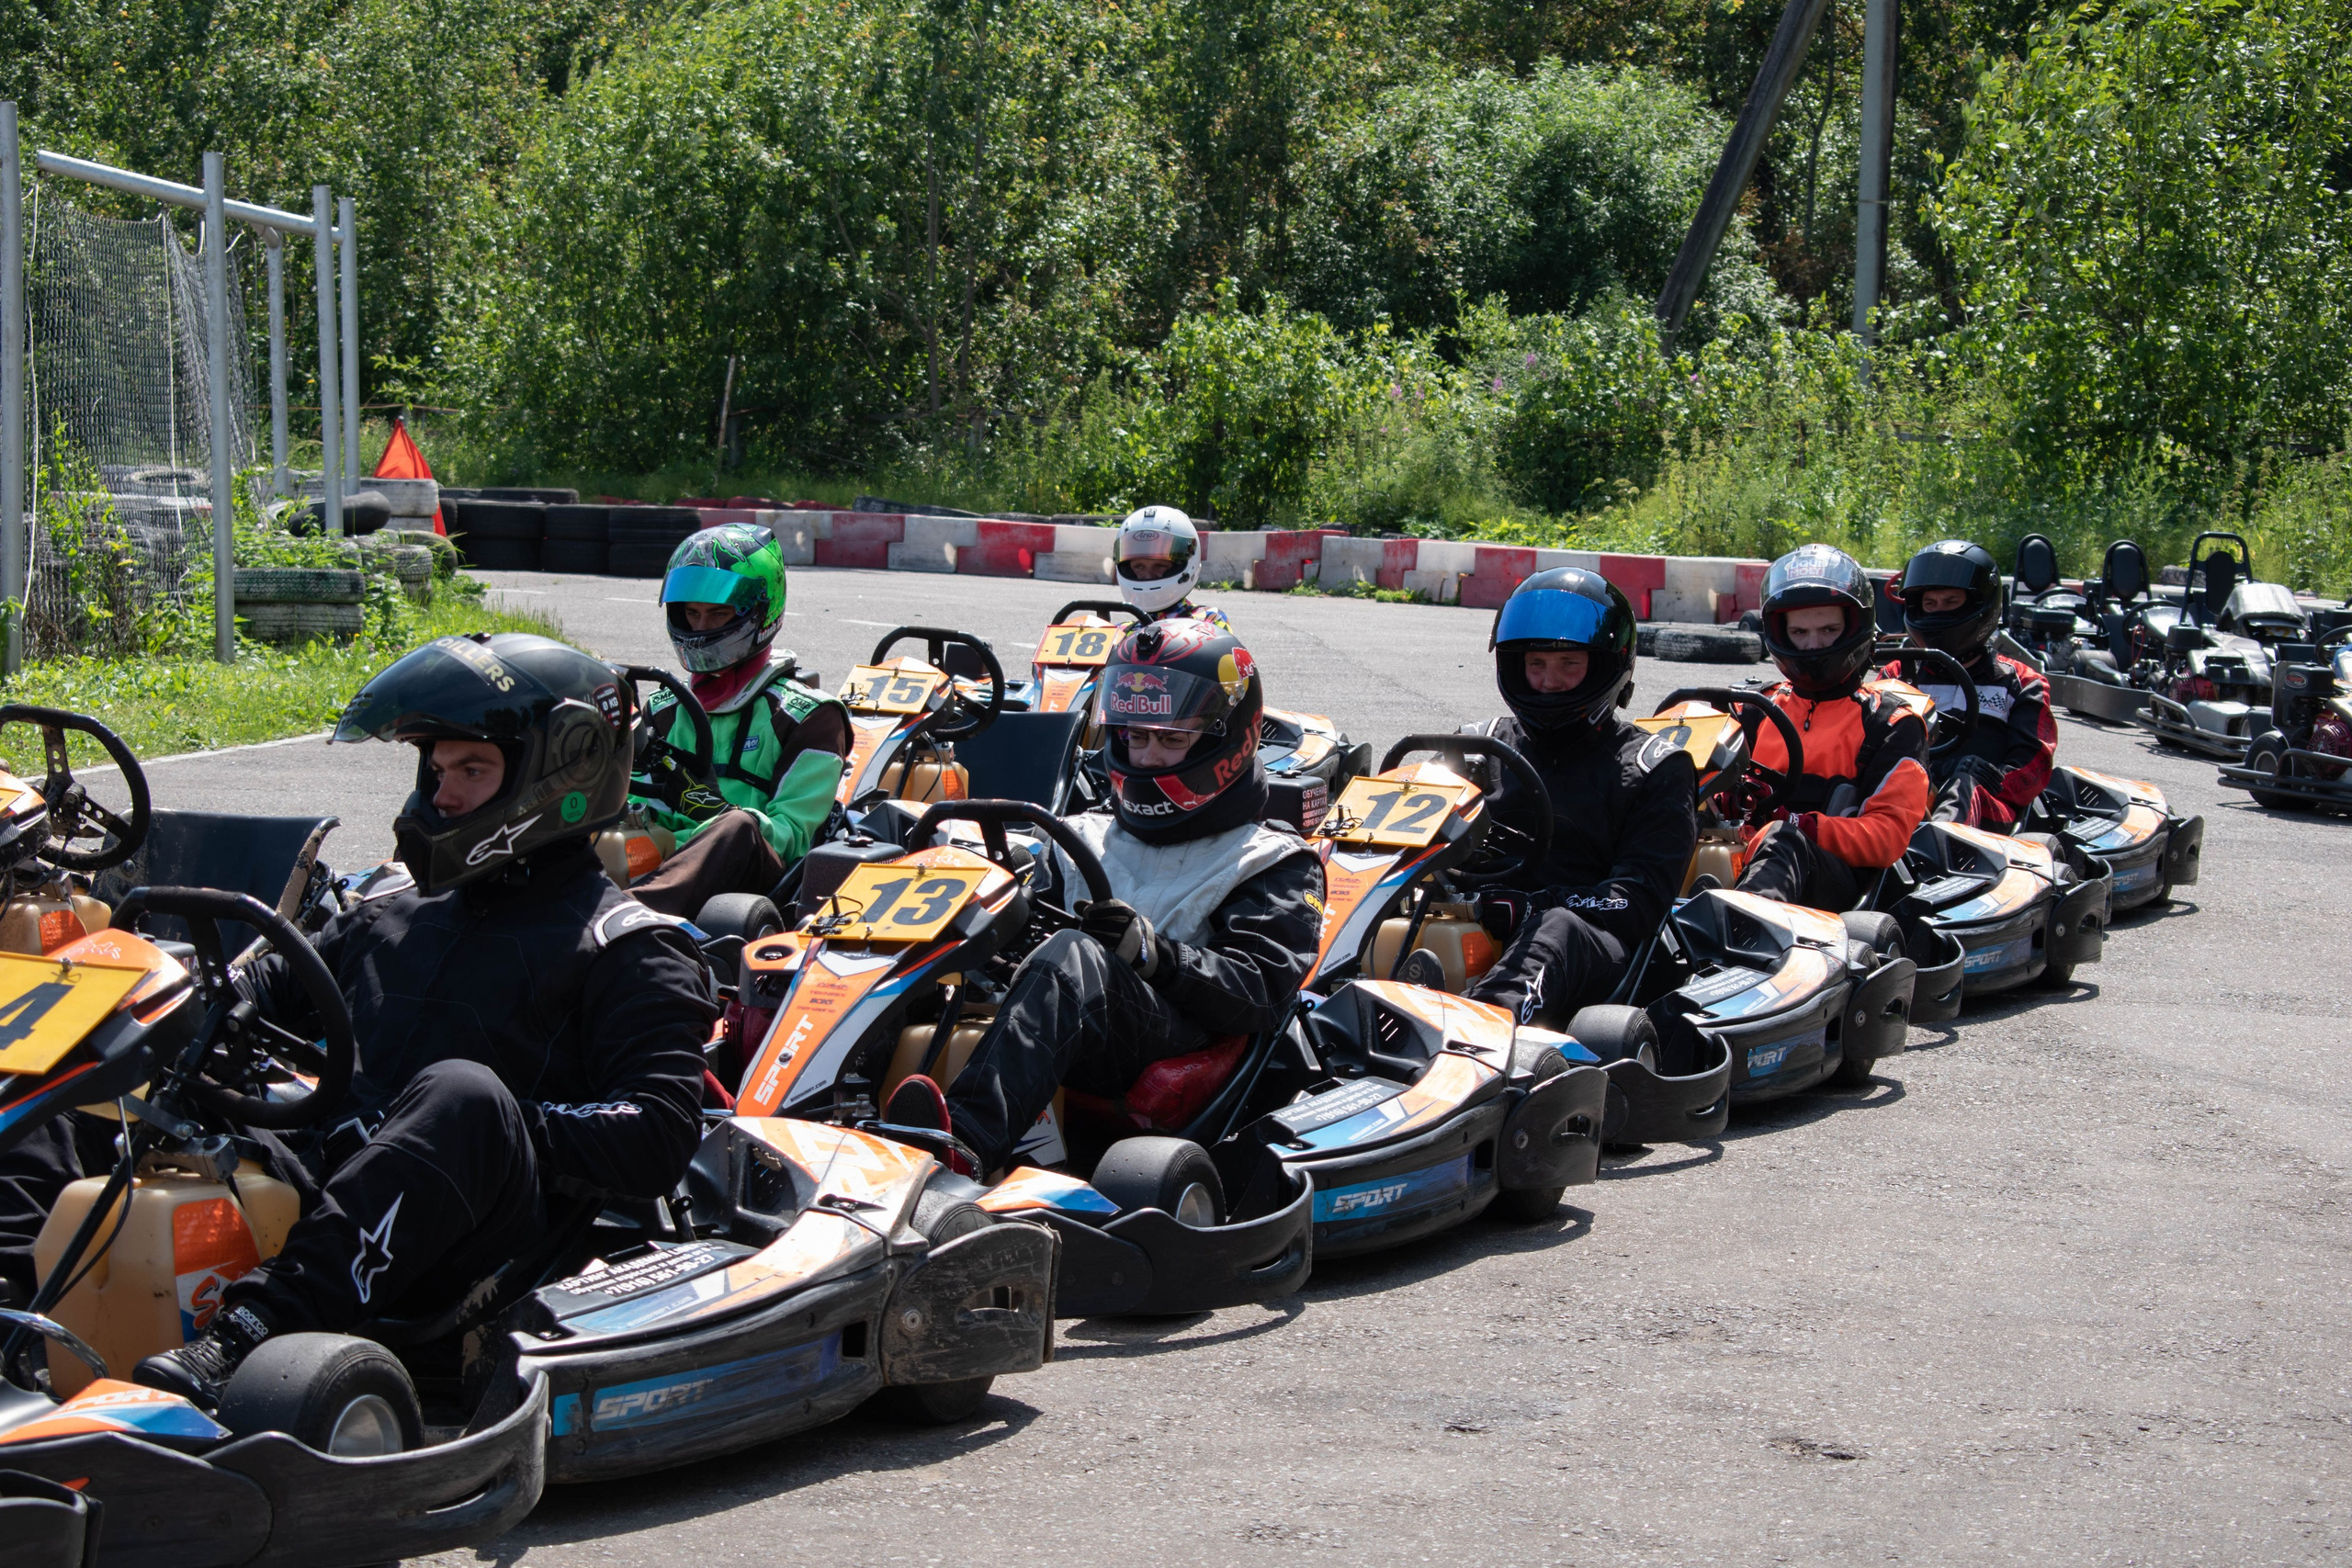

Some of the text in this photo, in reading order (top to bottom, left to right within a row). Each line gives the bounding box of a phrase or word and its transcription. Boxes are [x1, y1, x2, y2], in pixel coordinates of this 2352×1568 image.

[1138, 530, 1156, 538] Arai
[1788, 568, 1824, 579] MOLY
[1055, 632, 1108, 657] 18
[652, 692, 673, 704] OMP
[866, 675, 928, 704] 15
[1111, 692, 1171, 715] Red Bull
[790, 697, 813, 712] OMP
[1213, 727, 1253, 787] Red
[1302, 801, 1311, 811] НА
[1360, 791, 1447, 834] 12
[856, 877, 967, 926] 13
[1963, 950, 2003, 968] SPORT
[0, 982, 75, 1050] 4
[753, 1013, 814, 1105] SPORT
[1332, 1183, 1408, 1213] SPORT
[555, 1269, 610, 1292] КАРТИНГ
[608, 1250, 673, 1276] АКАДЕМИЯ
[235, 1305, 269, 1337] sparco
[595, 1380, 707, 1421] SPORT
